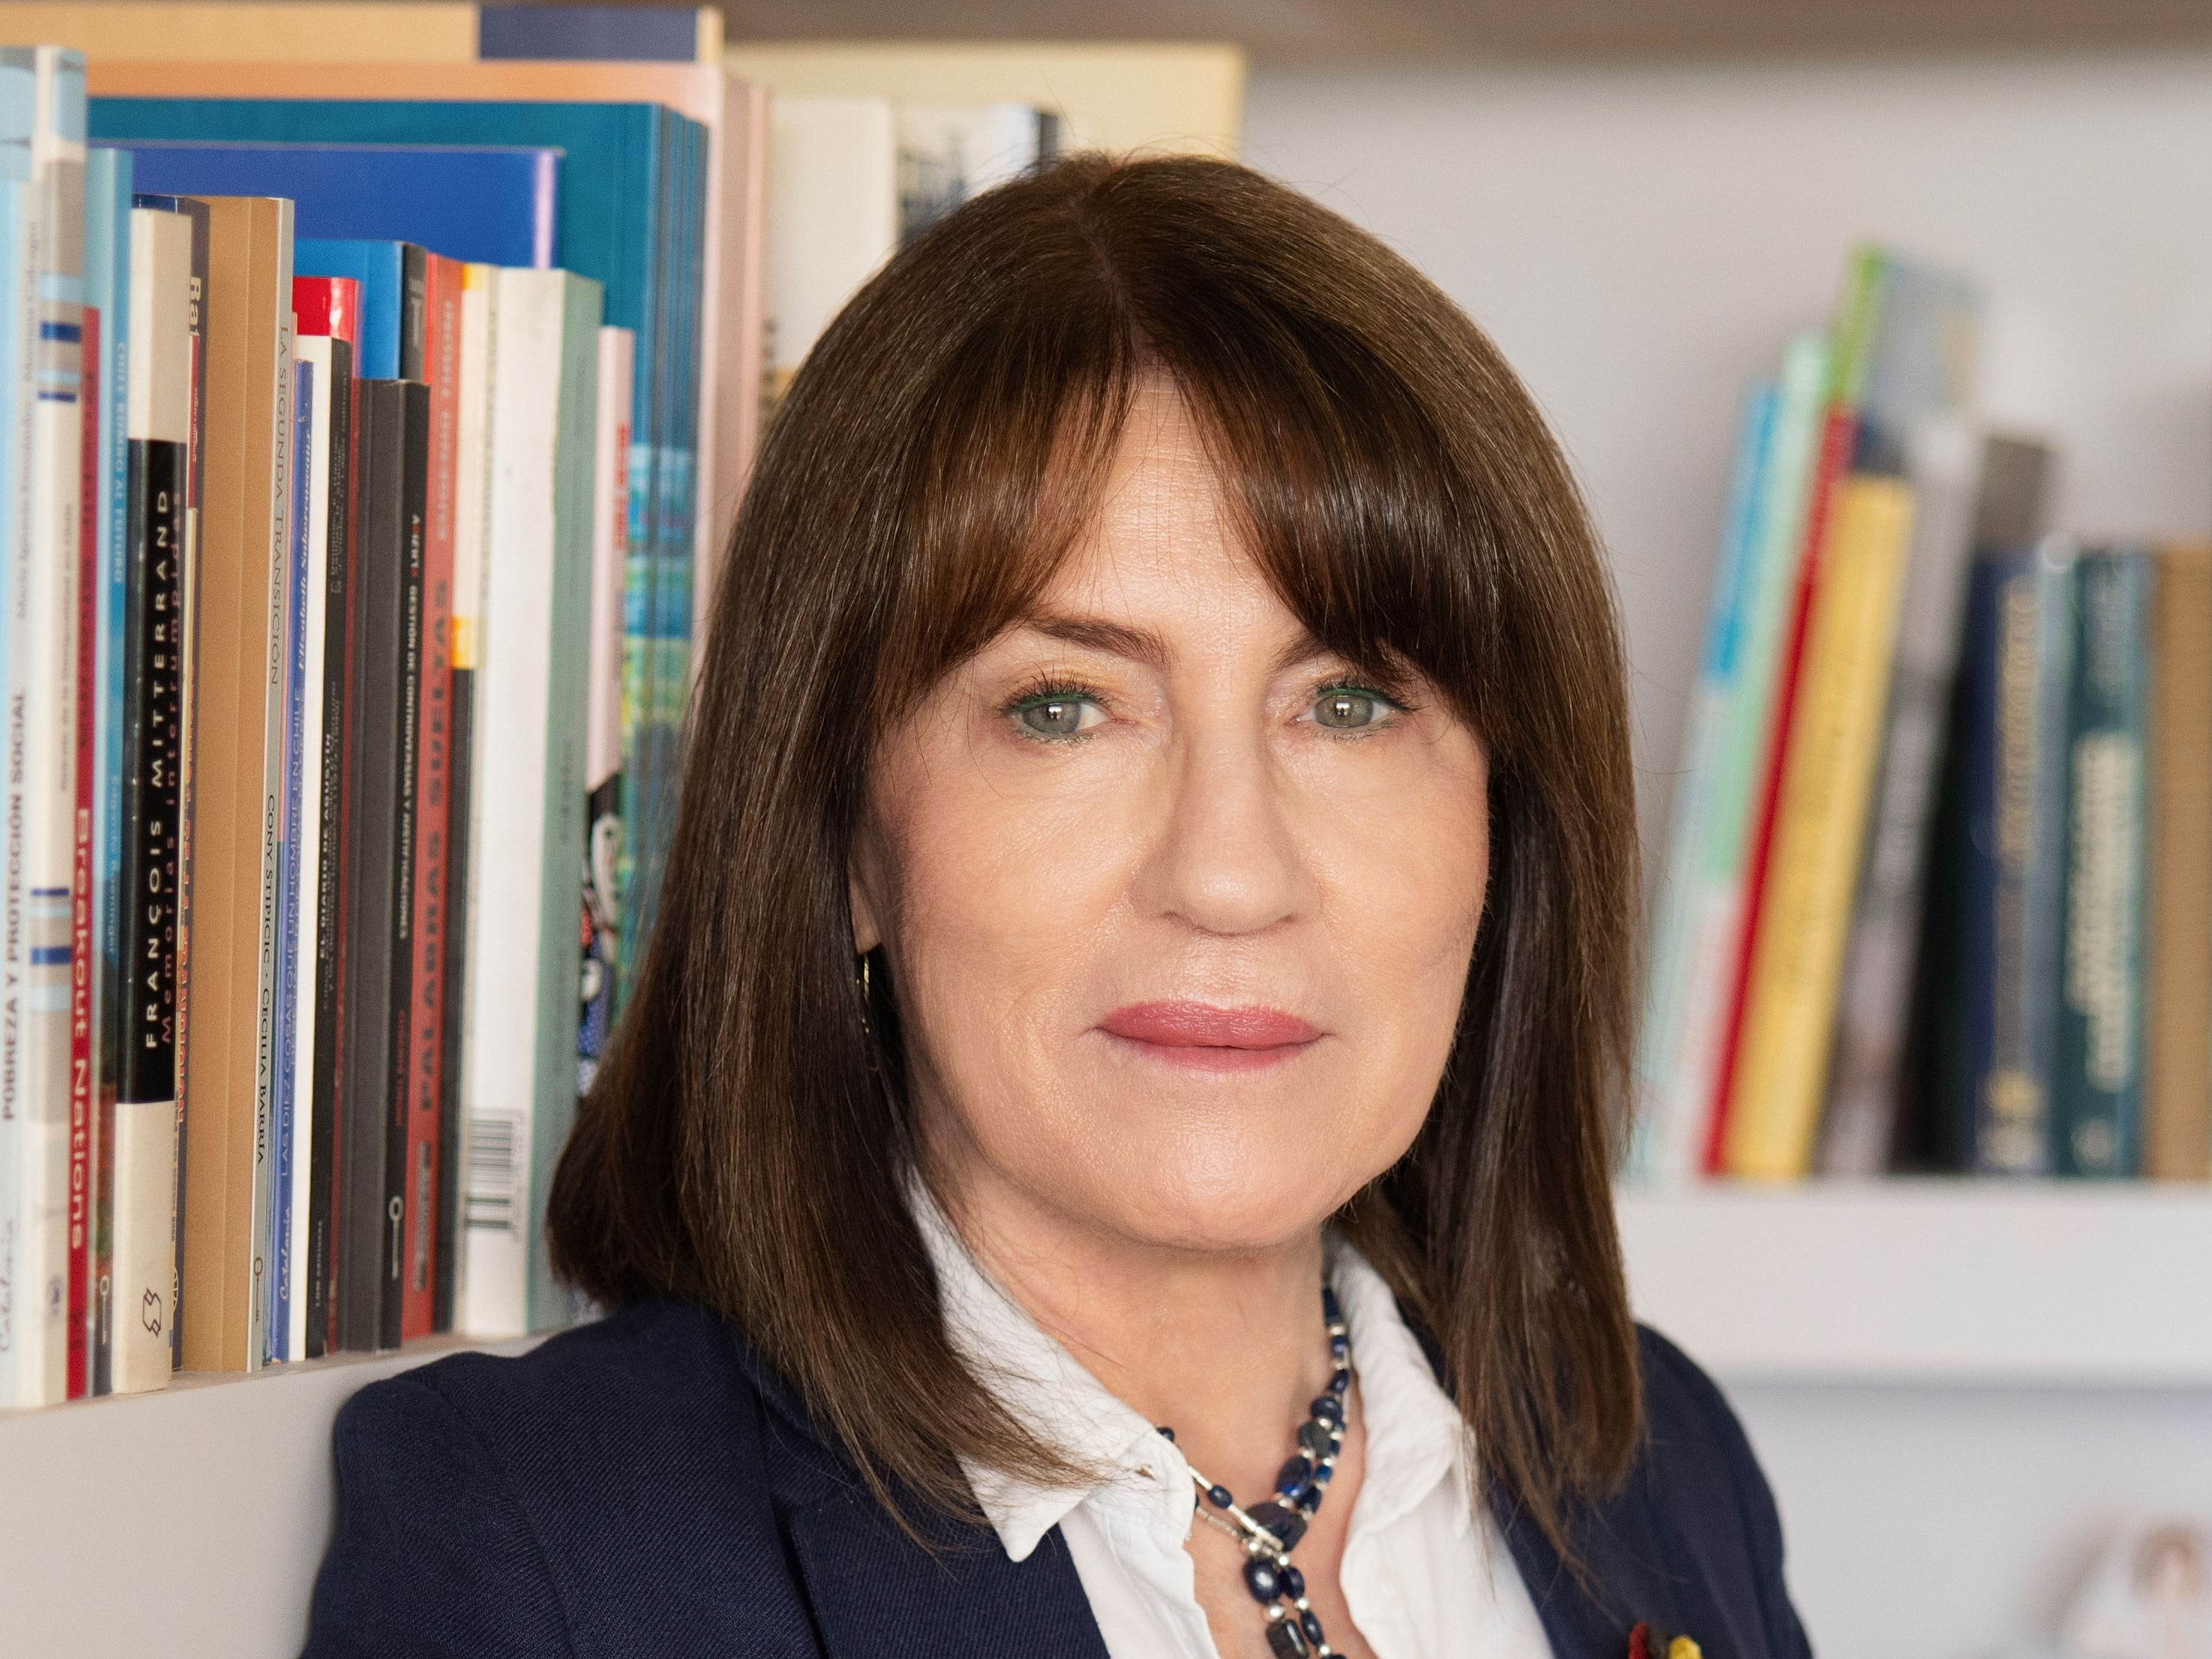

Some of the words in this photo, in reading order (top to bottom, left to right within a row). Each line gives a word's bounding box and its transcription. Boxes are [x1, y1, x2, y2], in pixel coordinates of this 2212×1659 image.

[280, 326, 289, 357] LA
[277, 367, 287, 502] SEGUNDA
[151, 490, 168, 788] MITTERRAND
[271, 509, 283, 686] TRANSICIÓN
[165, 490, 181, 806] interrumpidas
[10, 688, 25, 784] SOCIAL
[292, 761, 299, 791] EN
[266, 794, 275, 862] CONY
[289, 797, 298, 896] HOMBRE
[7, 794, 22, 962] PROTECCIÓN
[76, 811, 89, 1037] Breakout
[264, 868, 273, 964] STIPICIC
[287, 902, 296, 934] UN
[7, 973, 19, 988] Y
[145, 820, 160, 1048] FRANÇOIS
[161, 836, 175, 1044] Memorias
[2, 998, 18, 1120] POBREZA
[261, 988, 270, 1076] CECILIA
[284, 994, 292, 1073] COSAS
[72, 1059, 86, 1250] Nations
[258, 1085, 267, 1166] BARRÍA
[281, 1132, 289, 1177] LAS
